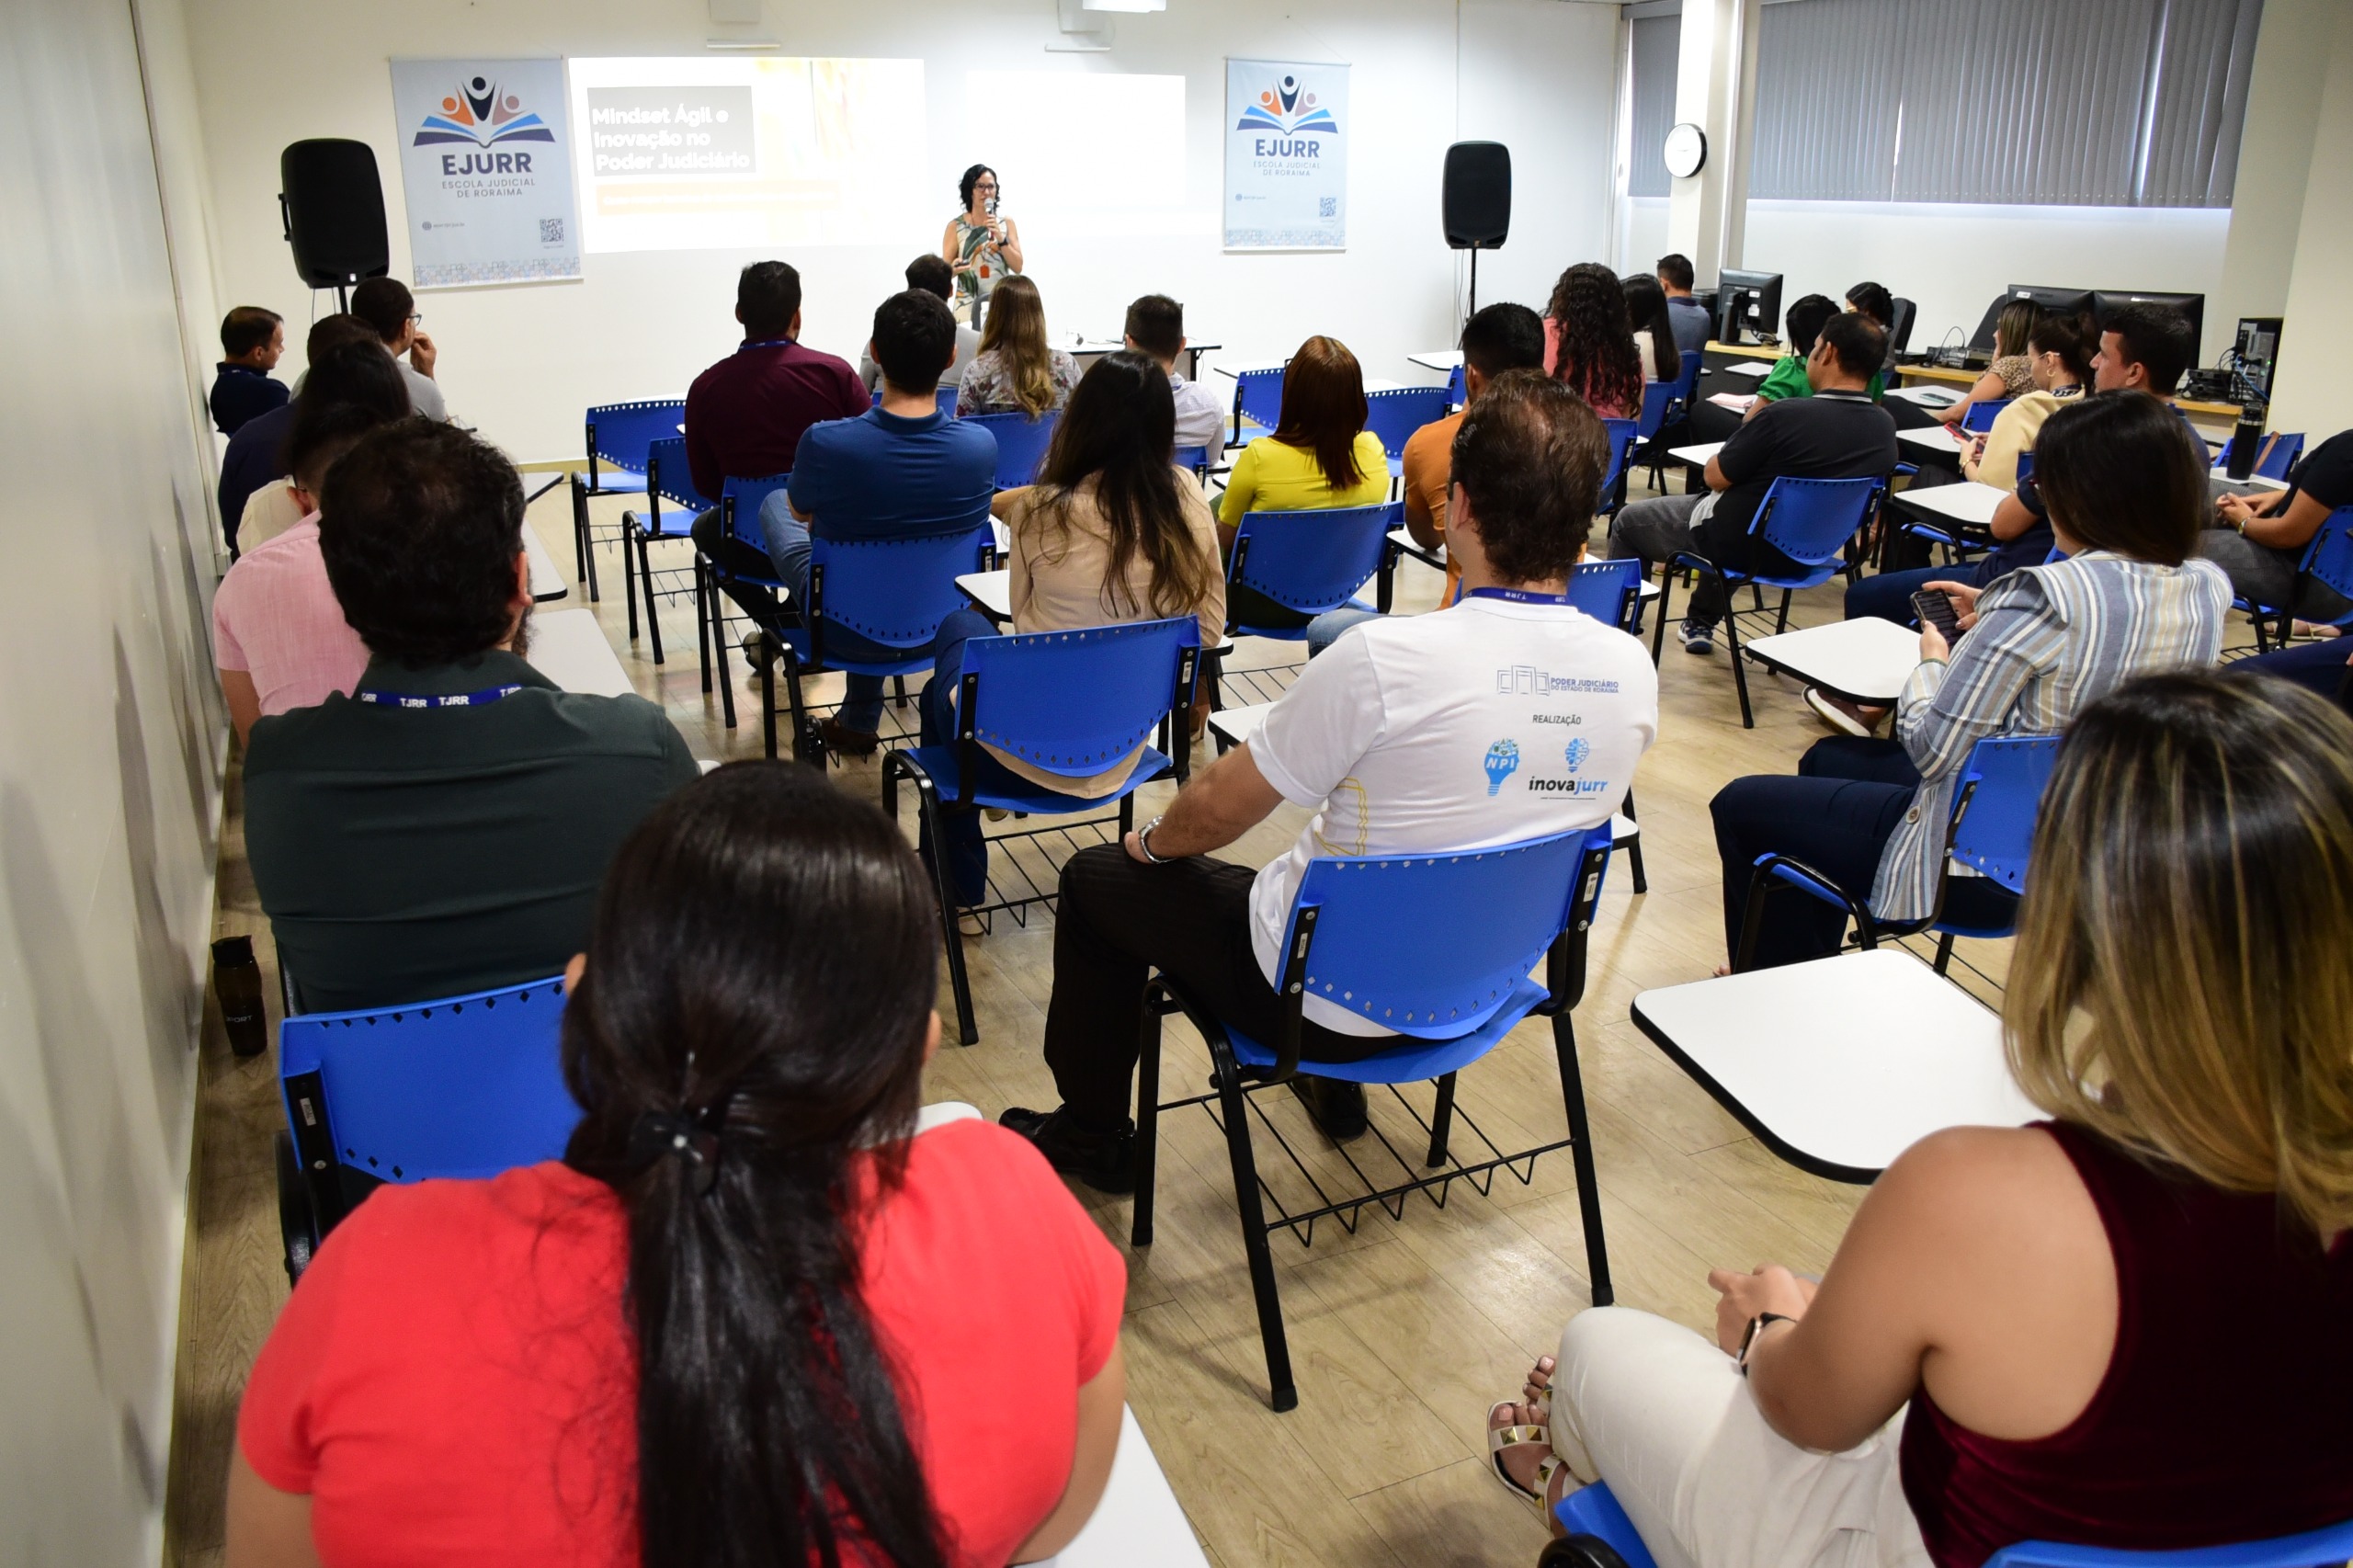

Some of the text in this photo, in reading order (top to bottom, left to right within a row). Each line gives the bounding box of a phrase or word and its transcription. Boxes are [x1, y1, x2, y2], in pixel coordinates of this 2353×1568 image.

[593, 103, 729, 127] Mindset Ágil e
[594, 130, 710, 150] Inovação no
[1256, 139, 1320, 158] EJURR
[441, 153, 532, 176] EJURR
[596, 151, 750, 171] Poder Judiciário
[442, 177, 536, 189] ESCOLA JUDICIAL
[457, 187, 523, 198] DE RORAIMA
[1505, 591, 1527, 600] TJRR
[1551, 677, 1619, 688] PODER JUDICIÁRIO
[400, 698, 427, 708] TJRR
[438, 695, 470, 706] TJRR
[1532, 714, 1581, 726] REALIZAÇÃO
[1485, 756, 1515, 769] NPI
[1529, 776, 1608, 795] inovajurr
